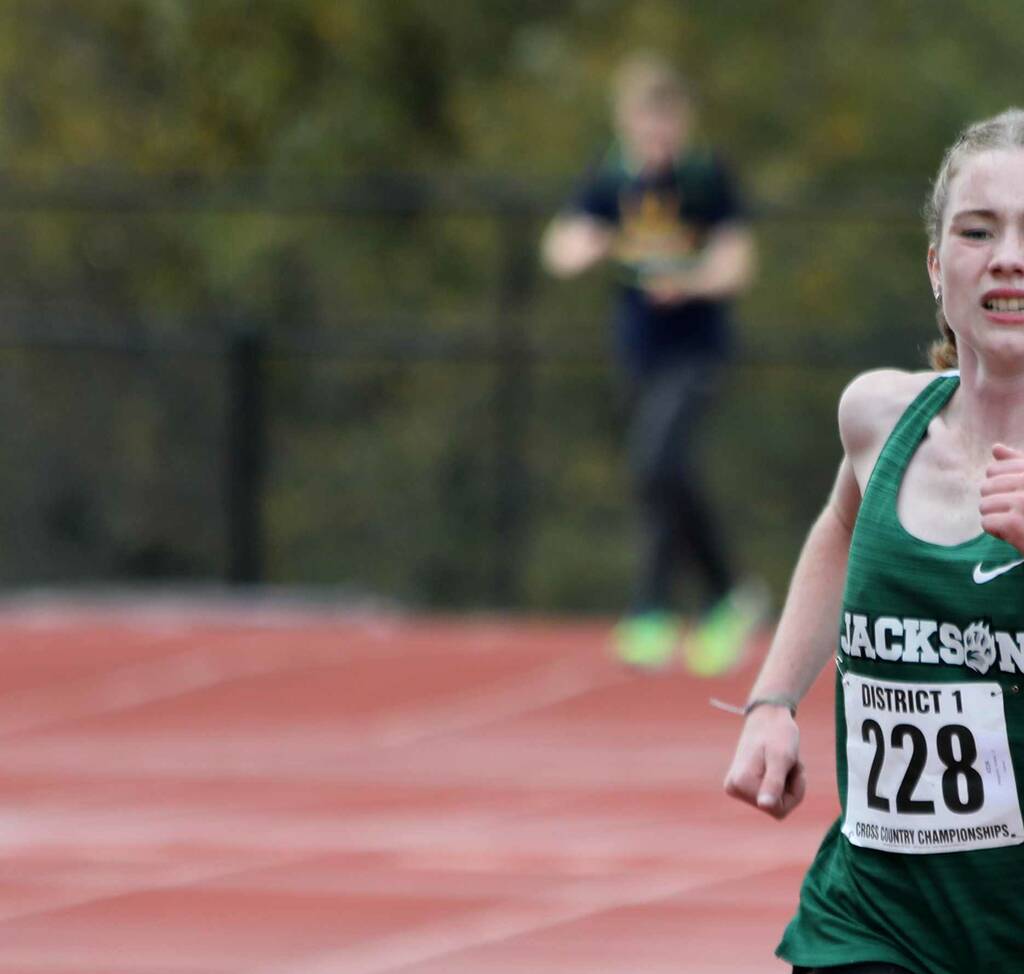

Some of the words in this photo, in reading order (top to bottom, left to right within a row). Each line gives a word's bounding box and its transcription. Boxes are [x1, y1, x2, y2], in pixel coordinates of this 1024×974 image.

[861, 683, 942, 714] DISTRICT
[951, 690, 964, 713] 1
[861, 718, 985, 815] 228
[855, 822, 880, 841] CROSS
[880, 826, 915, 845] COUNTRY
[917, 824, 1010, 845] CHAMPIONSHIPS
